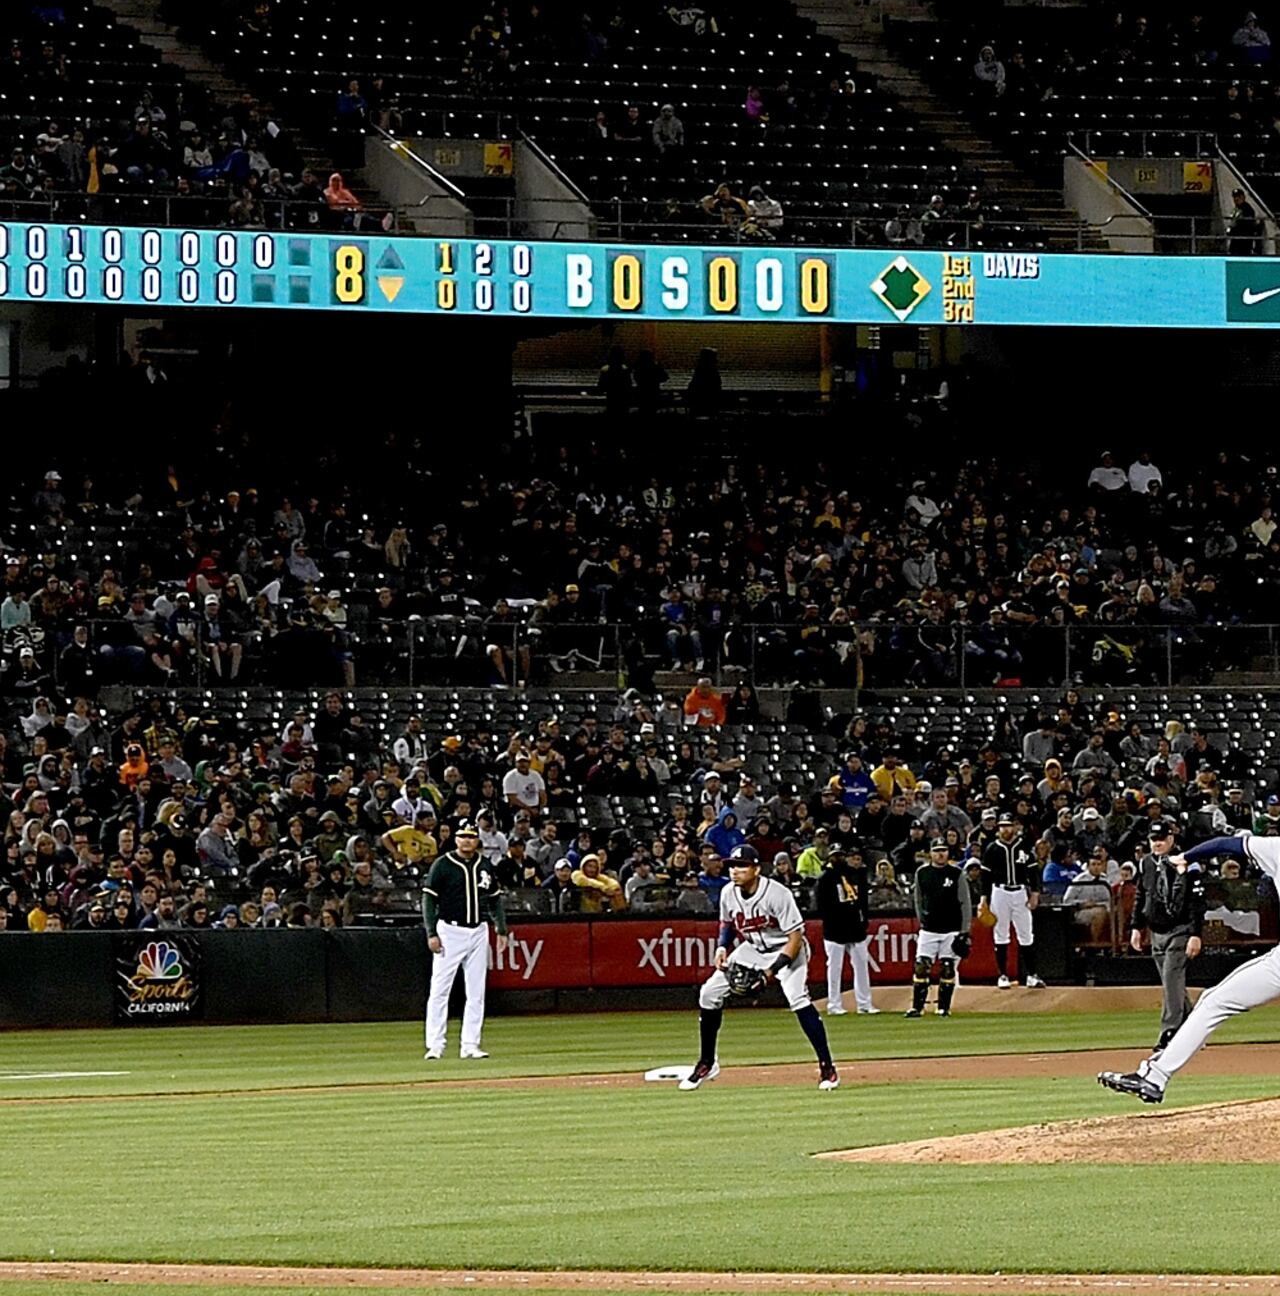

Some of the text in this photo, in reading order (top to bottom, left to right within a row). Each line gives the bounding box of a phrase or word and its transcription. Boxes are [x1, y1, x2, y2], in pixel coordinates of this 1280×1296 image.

[336, 246, 364, 302] 8
[984, 255, 1038, 277] DAVIS
[944, 275, 974, 297] 2nd
[944, 299, 973, 321] 3rd
[128, 976, 193, 1002] Sports
